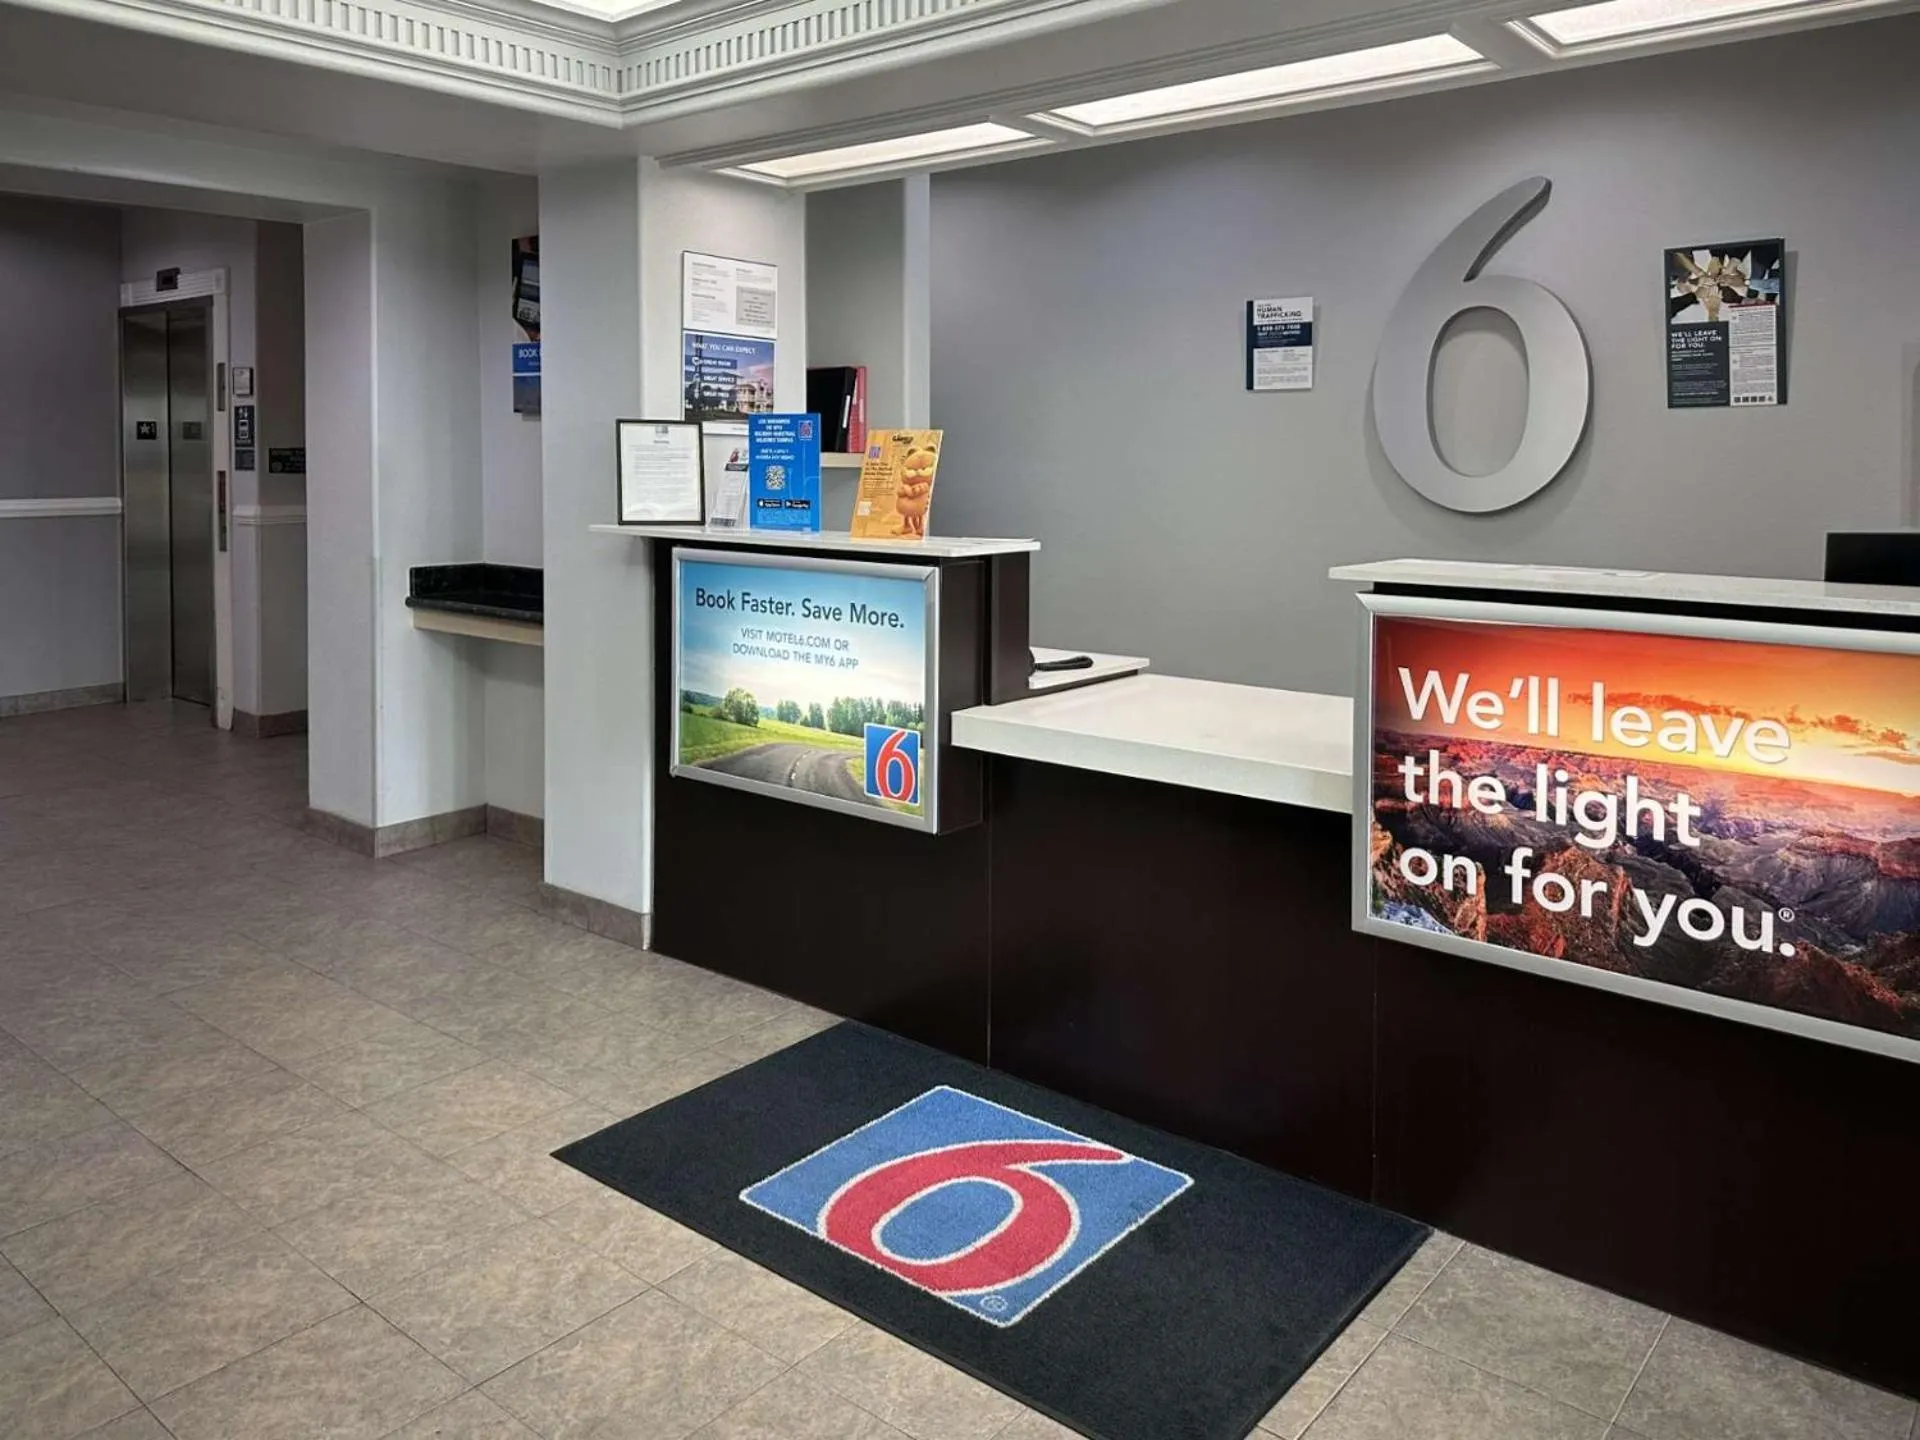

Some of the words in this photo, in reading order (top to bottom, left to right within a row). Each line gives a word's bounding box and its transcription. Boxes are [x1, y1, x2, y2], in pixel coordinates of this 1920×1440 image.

[1256, 311, 1302, 319] TRAFFICKING
[1373, 175, 1594, 513] 6
[1671, 330, 1693, 338] WE'LL
[1694, 329, 1717, 337] LEAVE
[695, 587, 736, 611] Book
[740, 592, 796, 617] Faster.
[801, 598, 843, 622] Save
[849, 602, 905, 629] More.
[741, 627, 763, 640] VISIT
[766, 630, 831, 649] MOTEL6.COM
[833, 638, 849, 651] OR
[732, 643, 790, 662] DOWNLOAD
[793, 650, 811, 664] THE
[814, 653, 836, 667] MY6
[838, 656, 859, 670] APP
[1398, 666, 1560, 737] We'll
[1591, 680, 1792, 763] leave
[875, 728, 916, 803] 6
[1398, 750, 1506, 815] the
[1535, 763, 1701, 849] light
[1399, 847, 1478, 895] on
[1504, 846, 1607, 918] for
[816, 1138, 1134, 1297] 6
